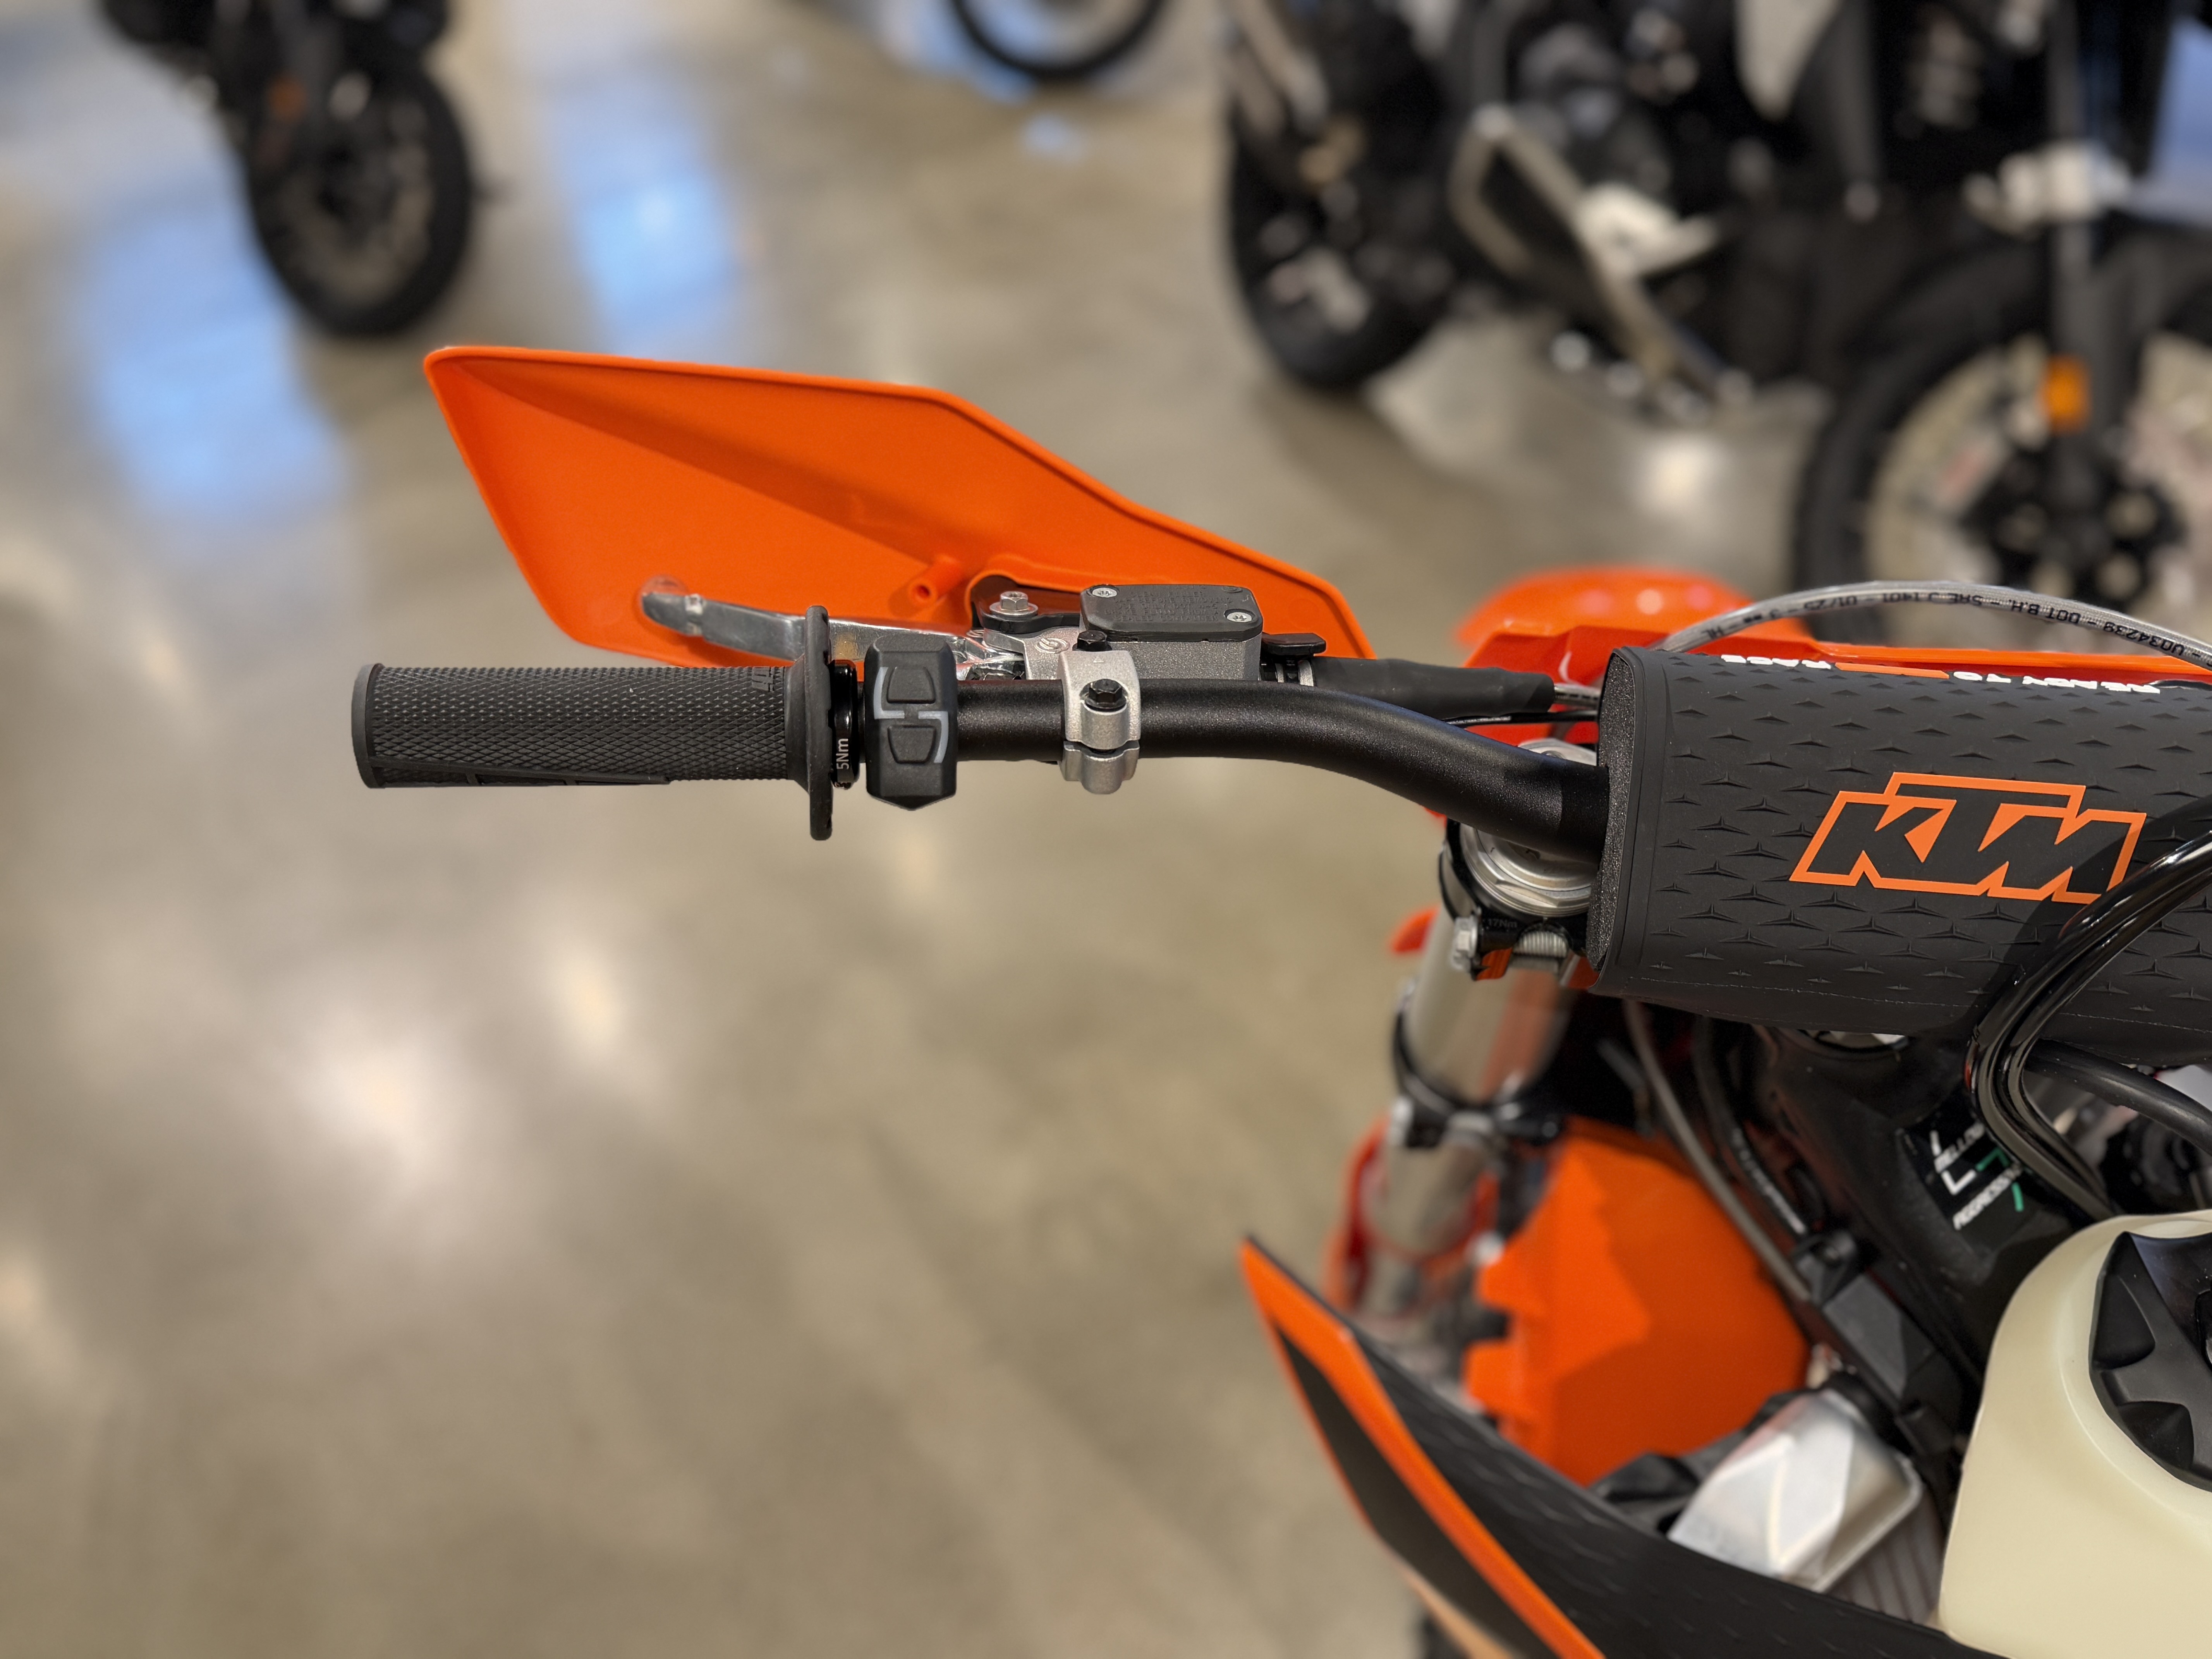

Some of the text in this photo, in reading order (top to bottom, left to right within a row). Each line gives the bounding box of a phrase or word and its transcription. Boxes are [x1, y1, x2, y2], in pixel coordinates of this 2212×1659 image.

[2045, 607, 2081, 624] DOT
[836, 738, 849, 769] 5Nm
[1788, 771, 2147, 904] KTM
[1488, 918, 1517, 928] 17Nm
